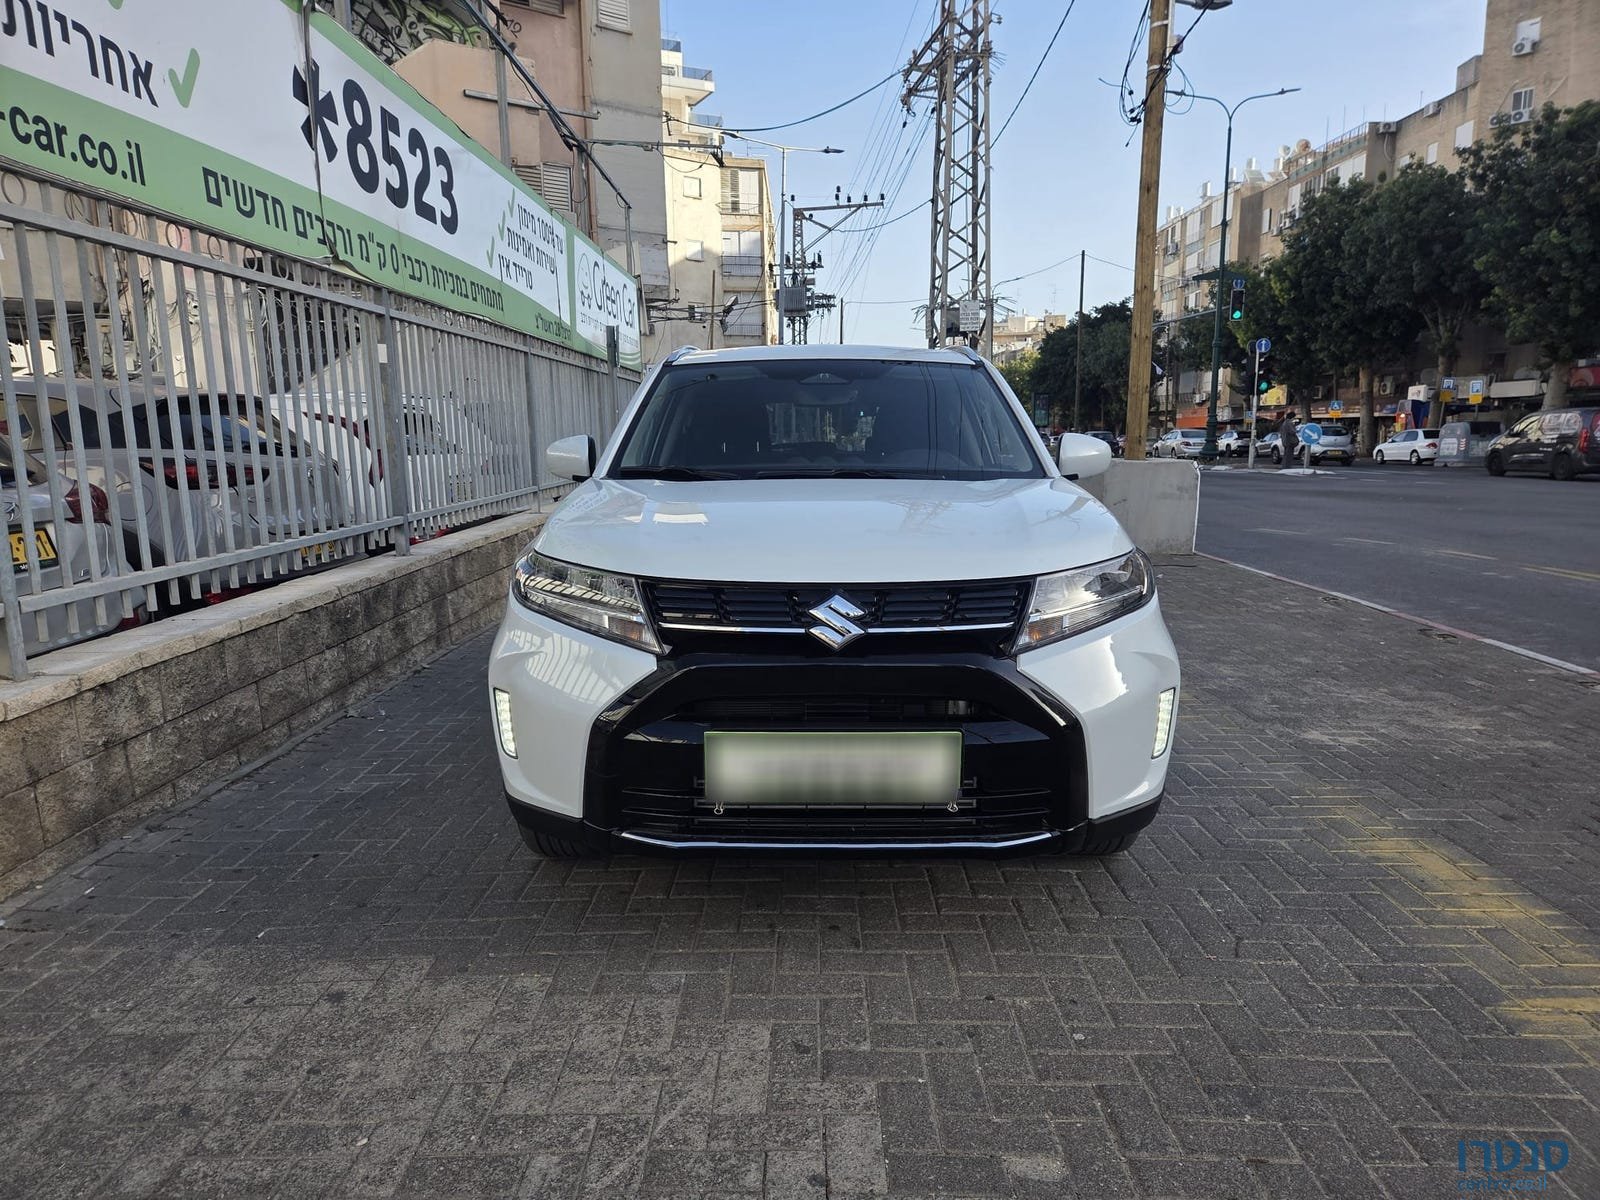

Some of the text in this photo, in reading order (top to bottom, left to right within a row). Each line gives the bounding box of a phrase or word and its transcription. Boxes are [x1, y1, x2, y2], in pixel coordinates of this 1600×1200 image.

[1, 0, 159, 108] אחריות
[202, 166, 288, 232] חדשים
[293, 205, 354, 257] ורכבים
[517, 203, 536, 235] מימון
[389, 243, 400, 274] 0
[506, 226, 535, 262] ואמינות
[401, 253, 430, 286] רכבי
[432, 264, 470, 299] במכירת
[498, 254, 533, 290] טרייד אין
[470, 280, 505, 312] מתמחים
[593, 260, 636, 329] Green Car
